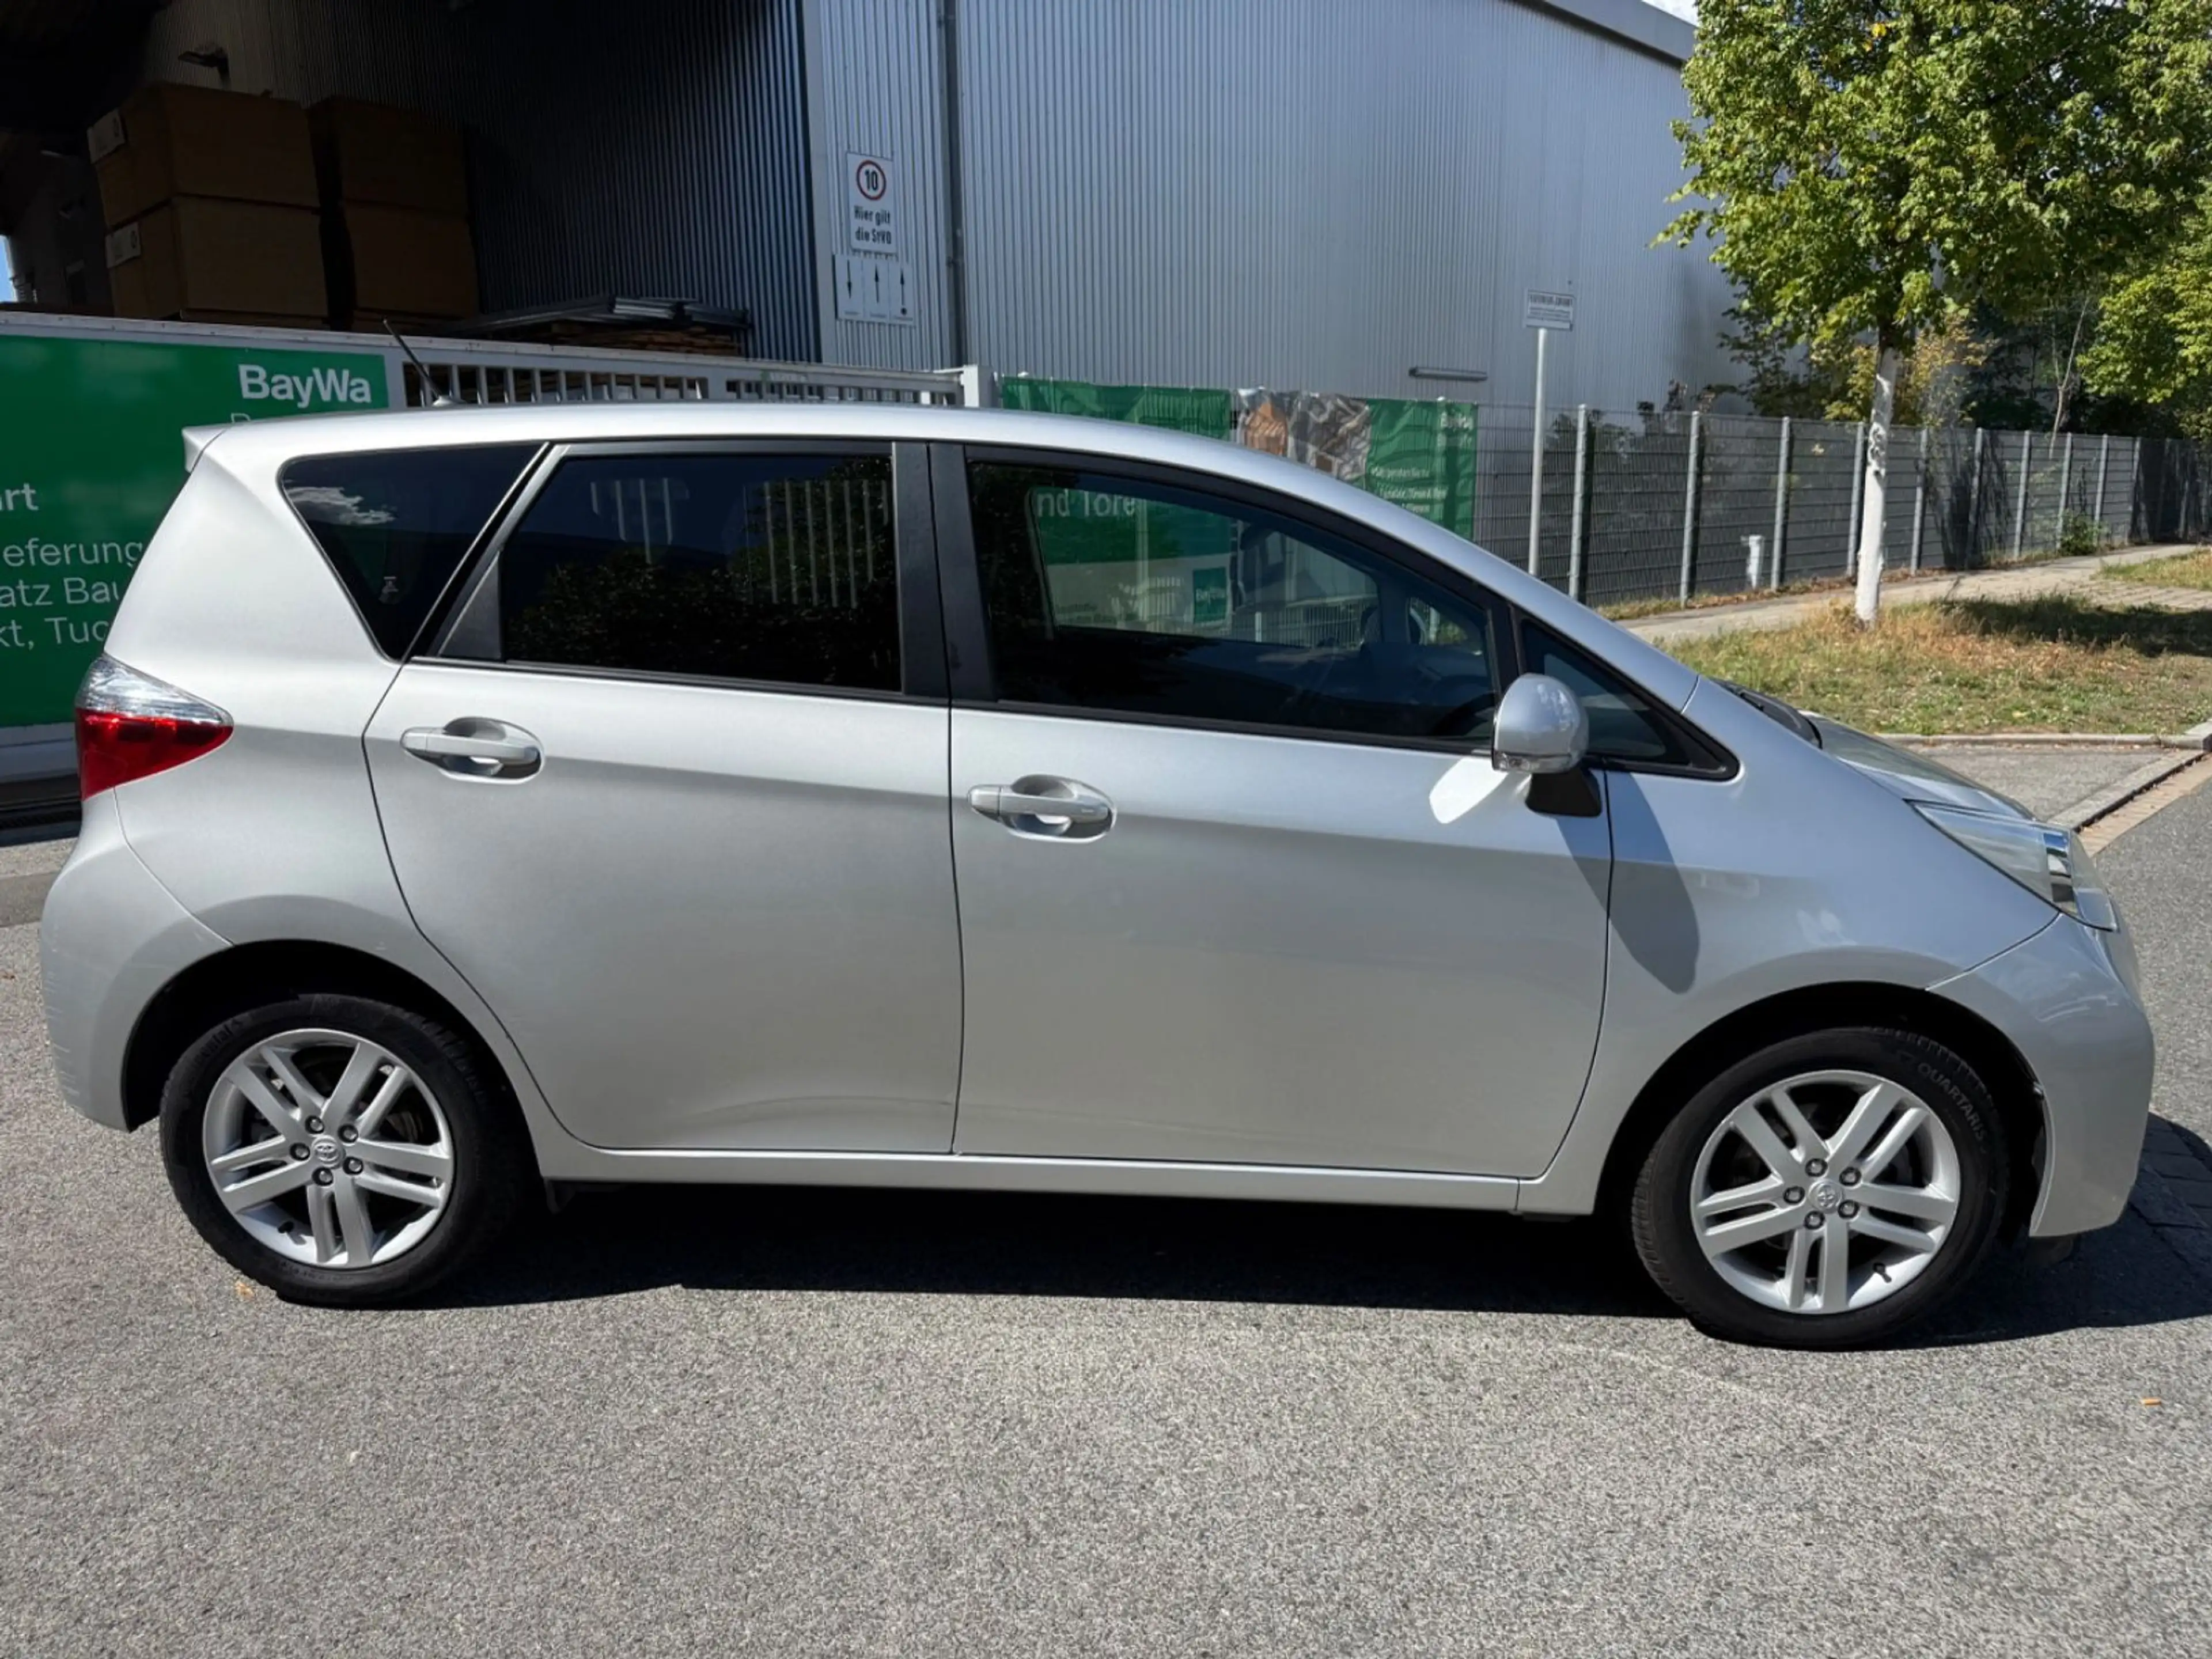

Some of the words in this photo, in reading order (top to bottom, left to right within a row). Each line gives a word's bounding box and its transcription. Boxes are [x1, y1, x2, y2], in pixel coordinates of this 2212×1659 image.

[865, 169, 878, 191] 10
[854, 205, 873, 222] Hier
[875, 209, 891, 226] gilt
[855, 226, 870, 242] die
[238, 364, 372, 408] BayWa
[0, 483, 39, 511] rt
